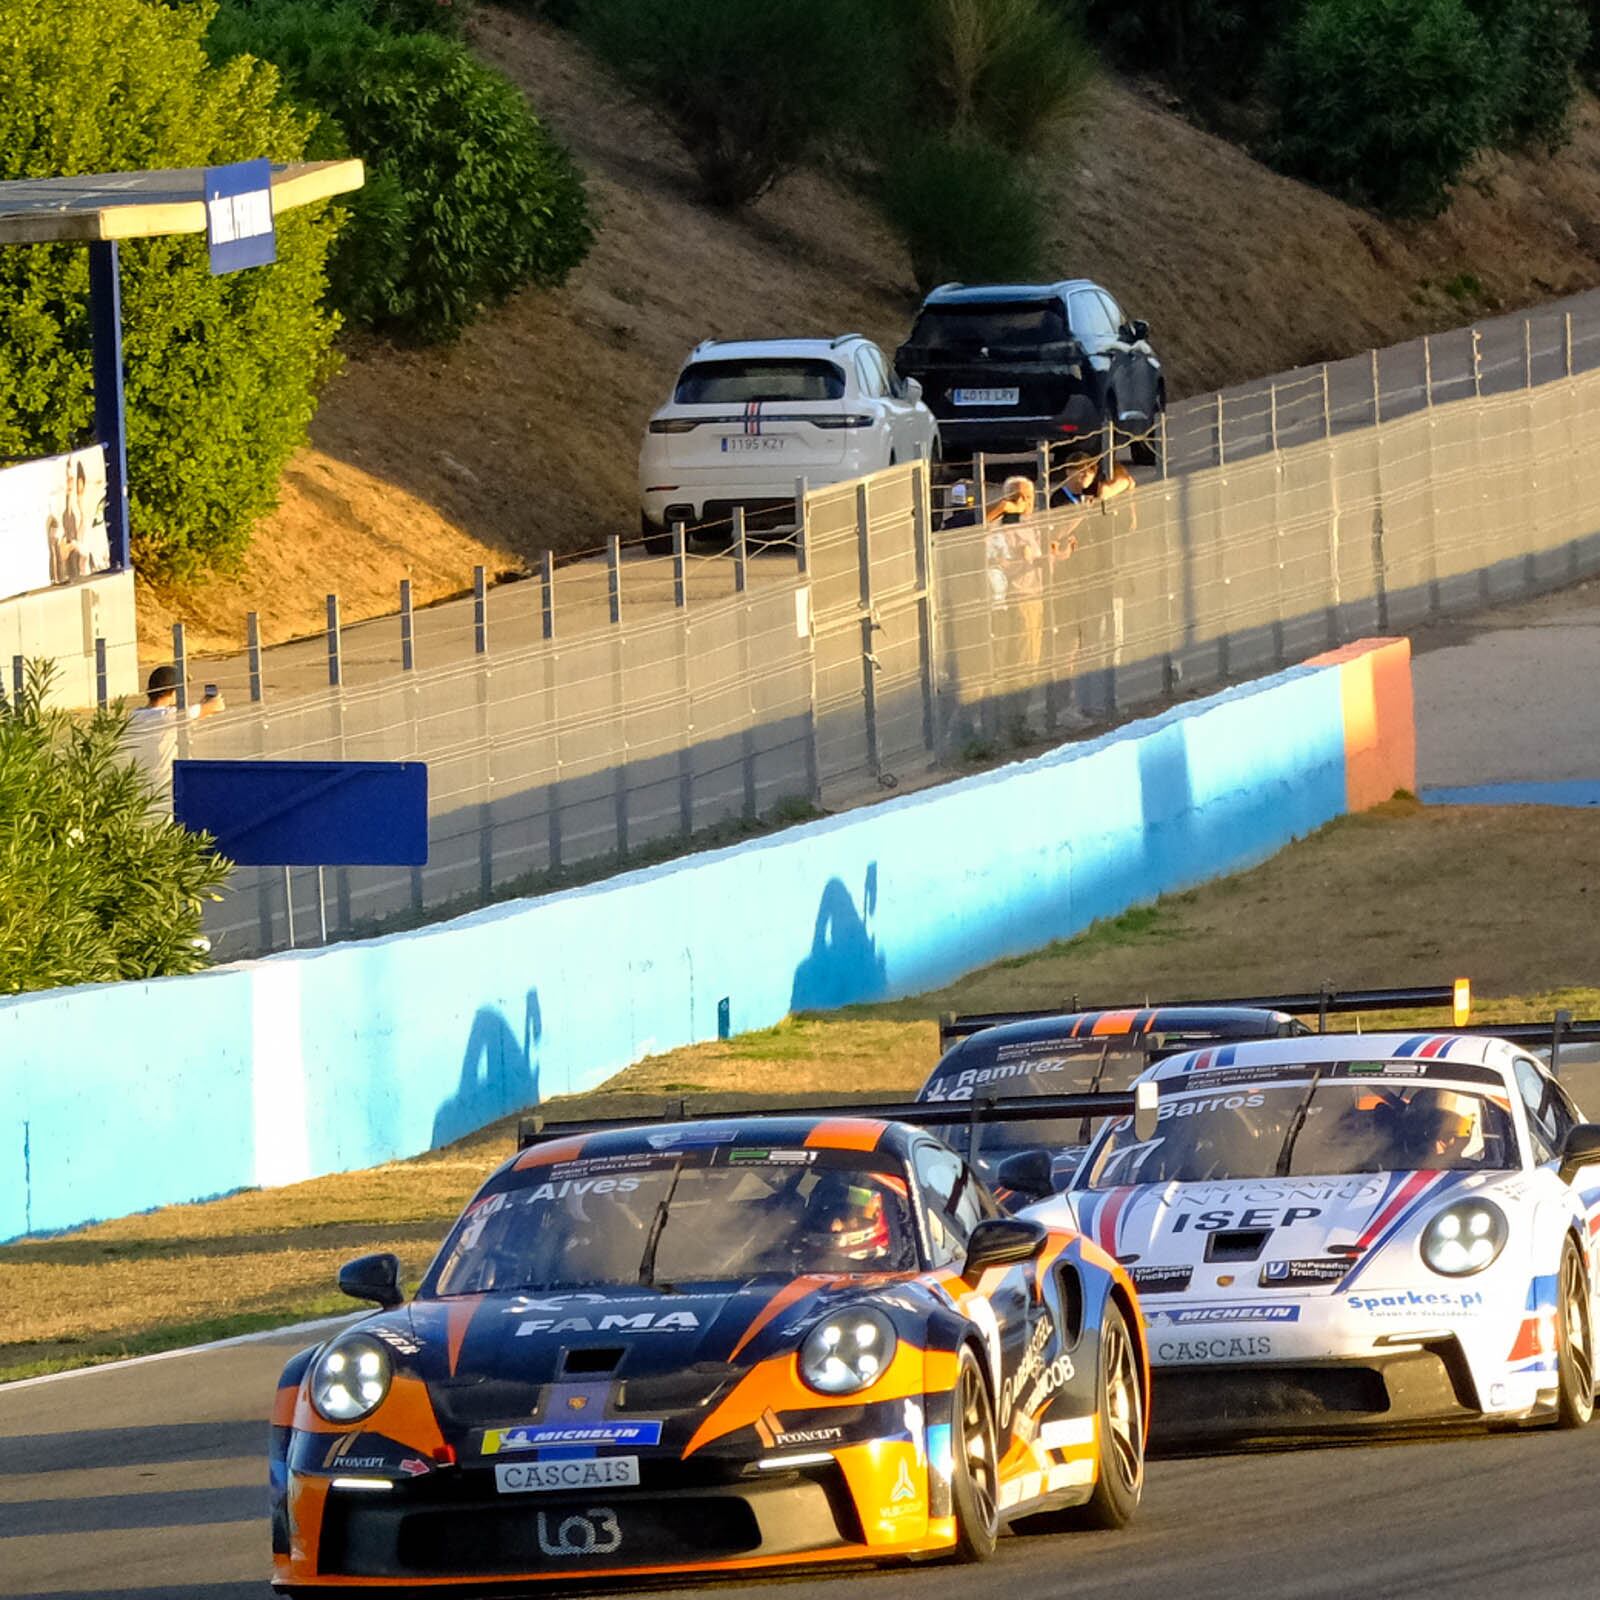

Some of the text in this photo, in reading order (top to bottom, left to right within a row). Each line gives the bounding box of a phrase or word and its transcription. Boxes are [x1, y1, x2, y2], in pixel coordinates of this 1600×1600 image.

[957, 1059, 1067, 1088] Ramirez
[1157, 1094, 1265, 1121] Barros
[1103, 1138, 1165, 1178] 77
[472, 1176, 640, 1218] M. Alves
[1172, 1207, 1321, 1233] ISEP
[1347, 1290, 1483, 1311] Sparkes.pt
[515, 1311, 700, 1337] FAMA
[1178, 1307, 1290, 1322] MICHELIN
[1158, 1337, 1271, 1361] CASCAIS
[533, 1428, 639, 1443] MICHELIN
[504, 1461, 630, 1488] CASCAIS
